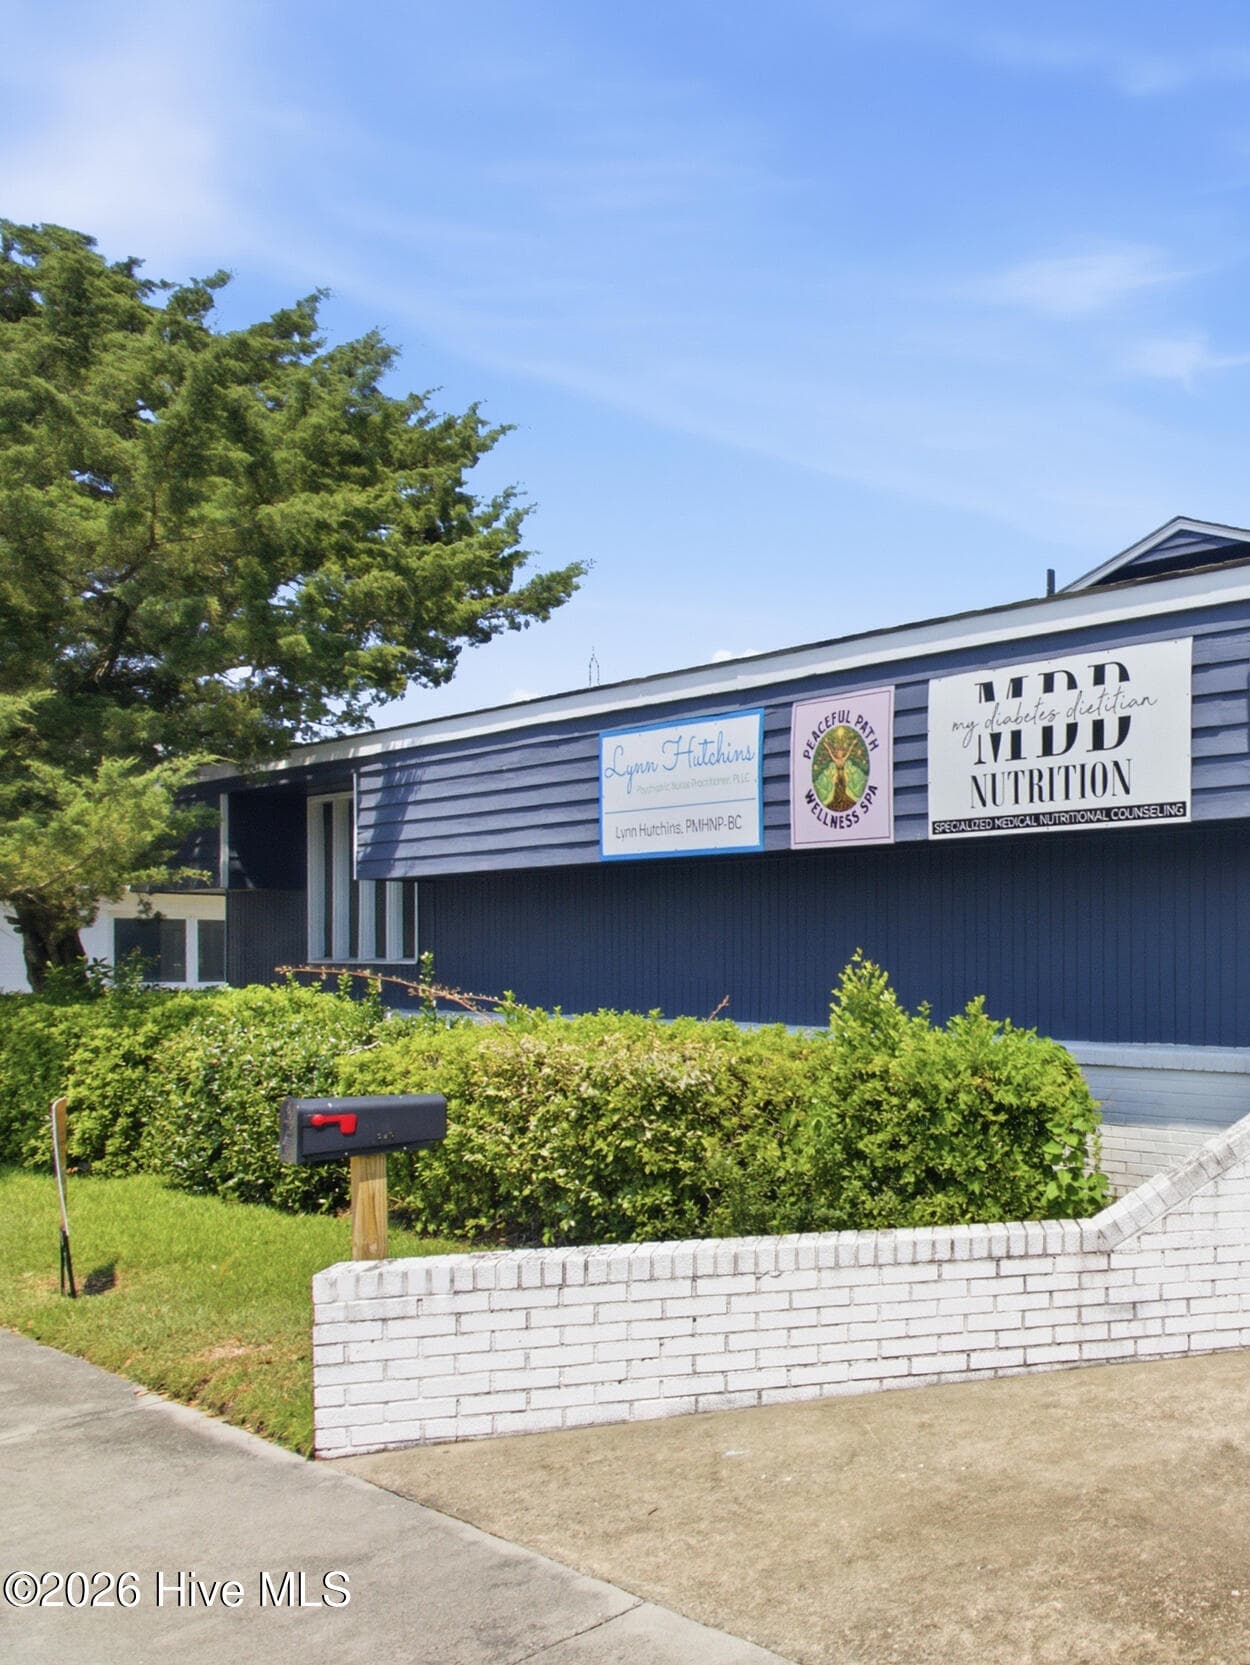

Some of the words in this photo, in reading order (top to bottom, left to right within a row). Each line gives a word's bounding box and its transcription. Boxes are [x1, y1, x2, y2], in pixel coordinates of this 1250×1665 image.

[803, 709, 851, 760] PEACEFUL
[854, 714, 879, 752] PATH
[952, 720, 978, 748] my
[984, 697, 1060, 733] diabetes
[1066, 686, 1158, 722] dietitian
[604, 745, 659, 795] Lynn
[661, 730, 755, 771] Hutchins
[970, 758, 1133, 810] NUTRITION
[615, 825, 638, 842] Lynn
[685, 814, 743, 833] PMHNP-BC
[805, 788, 860, 829] WELLNESS
[863, 784, 878, 814] SPA
[934, 819, 993, 833] SPECIALIZED
[995, 815, 1038, 829] MEDICAL
[1040, 809, 1109, 825] NUTRITIONAL
[1111, 803, 1184, 820] COUNSELING
